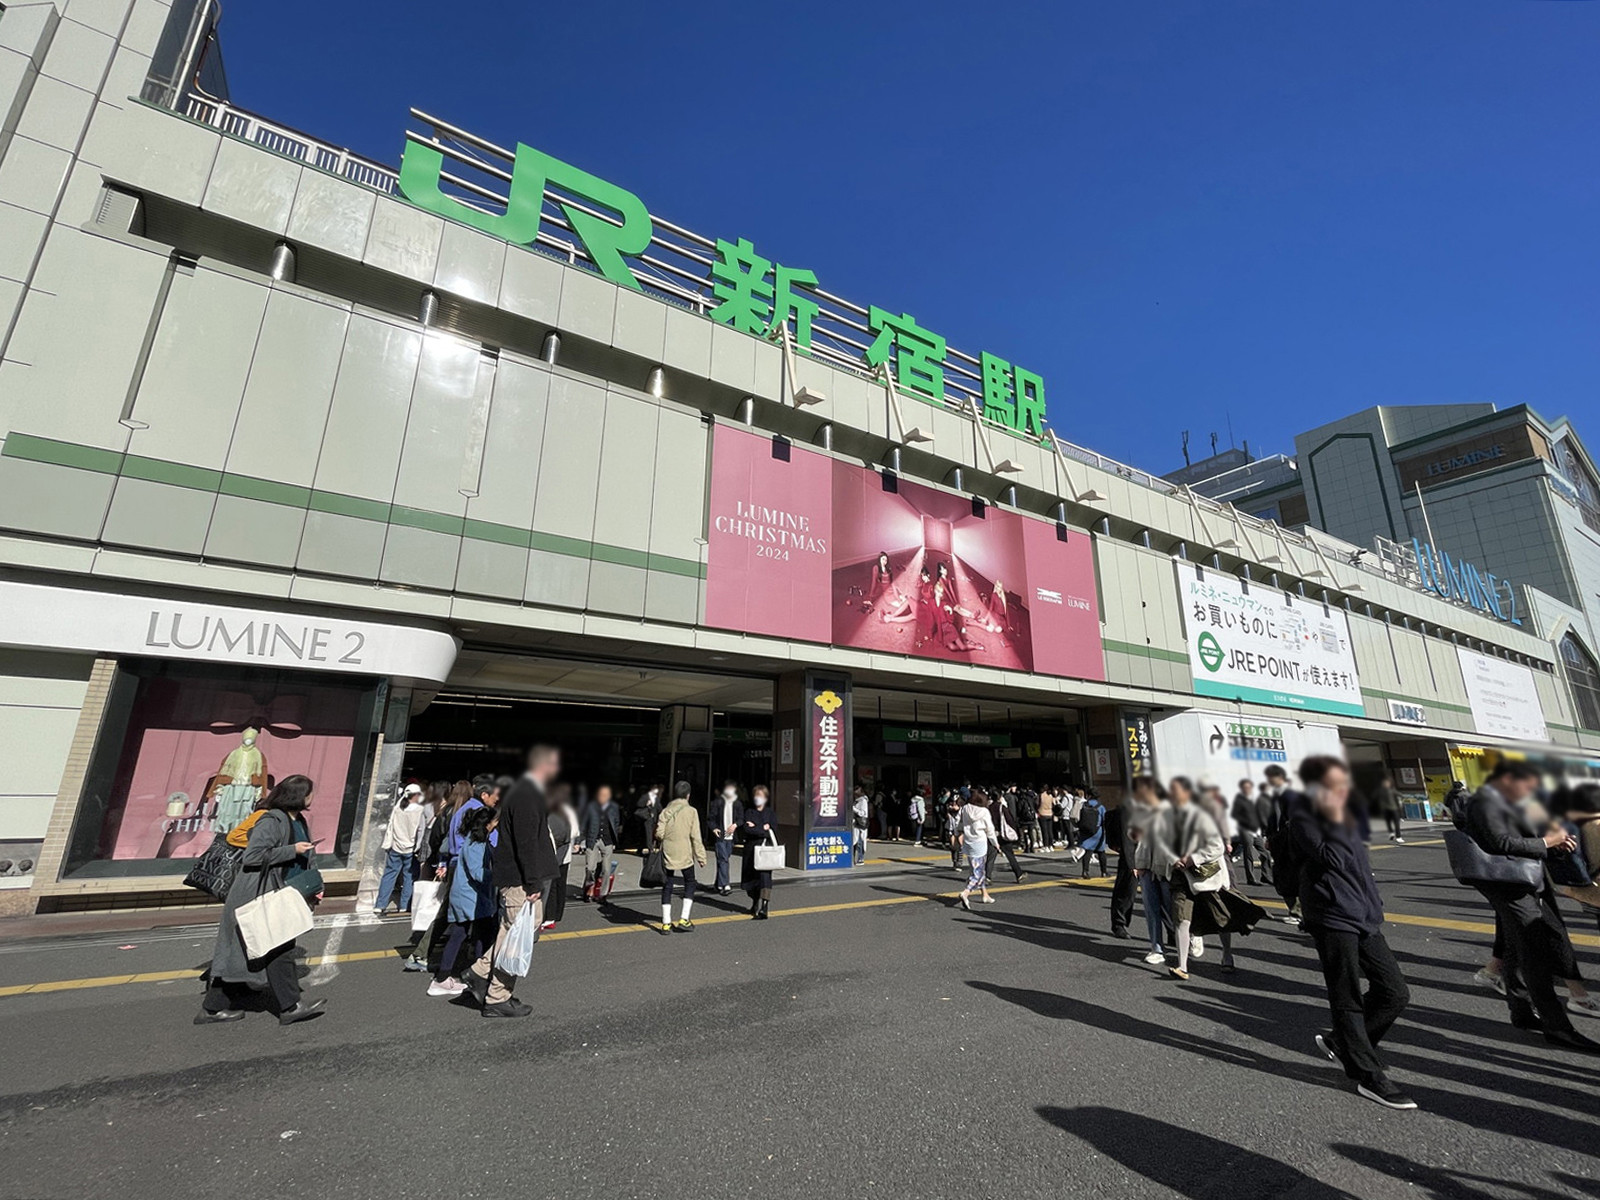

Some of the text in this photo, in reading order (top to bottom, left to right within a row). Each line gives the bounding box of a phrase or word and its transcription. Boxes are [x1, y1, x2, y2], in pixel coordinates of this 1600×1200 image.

[400, 139, 1047, 440] JR 新宿駅
[1427, 444, 1505, 475] LUMINE
[715, 515, 827, 555] CHRISTMAS
[737, 500, 810, 532] LUMINE
[756, 544, 790, 561] 2024
[1412, 537, 1523, 626] LUMINE 2
[145, 611, 365, 665] LUMINE 2
[1193, 600, 1278, 639] お買いものに
[1227, 648, 1257, 673] JRE
[1257, 655, 1301, 682] POINT
[818, 715, 839, 818] 住友不動産
